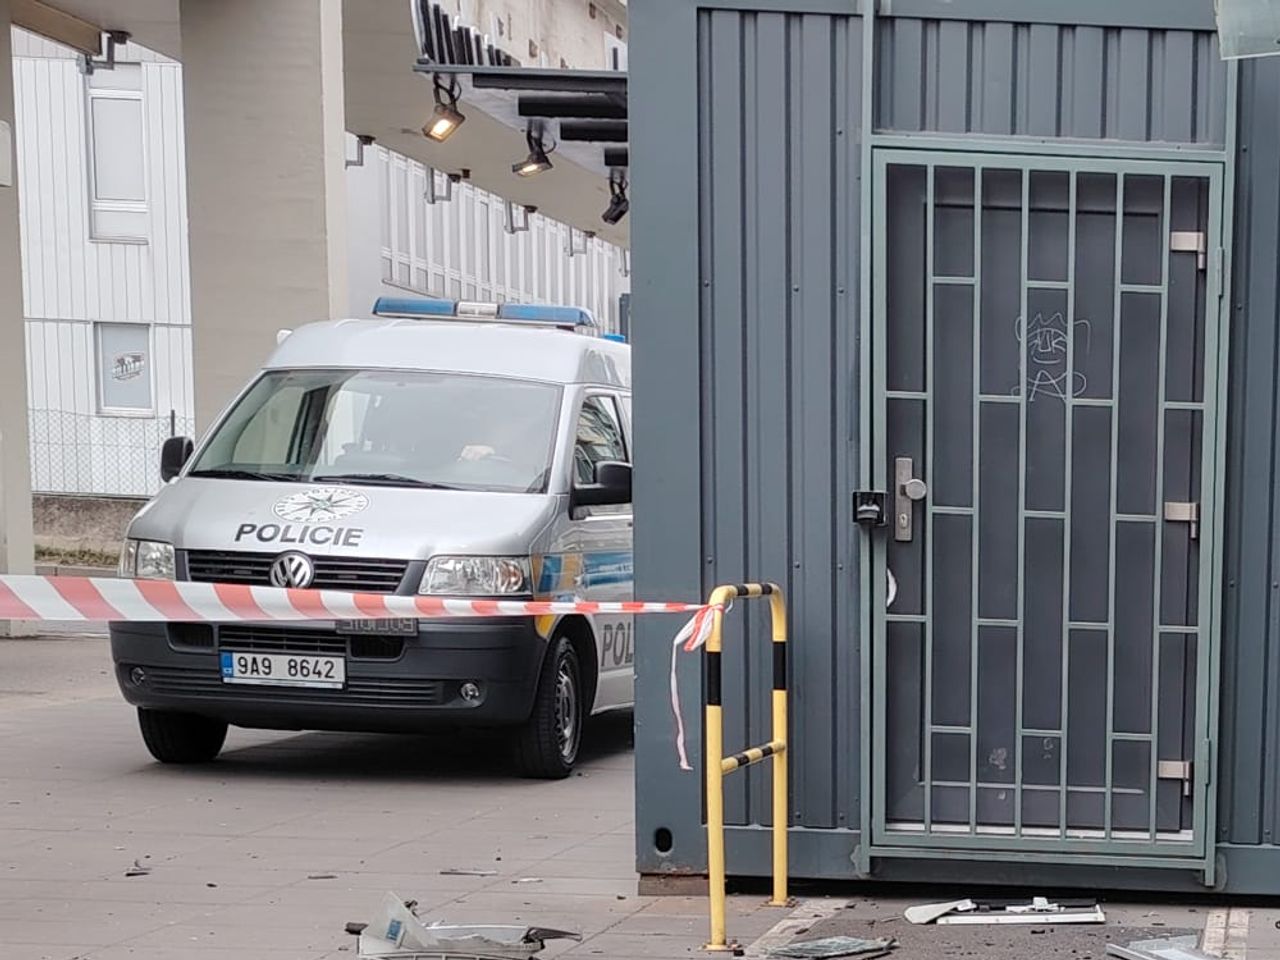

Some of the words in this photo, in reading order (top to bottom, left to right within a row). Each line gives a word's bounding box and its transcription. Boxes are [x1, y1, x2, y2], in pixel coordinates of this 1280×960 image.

[235, 523, 364, 547] POLICIE
[237, 656, 272, 676] 9A9
[288, 658, 335, 679] 8642
